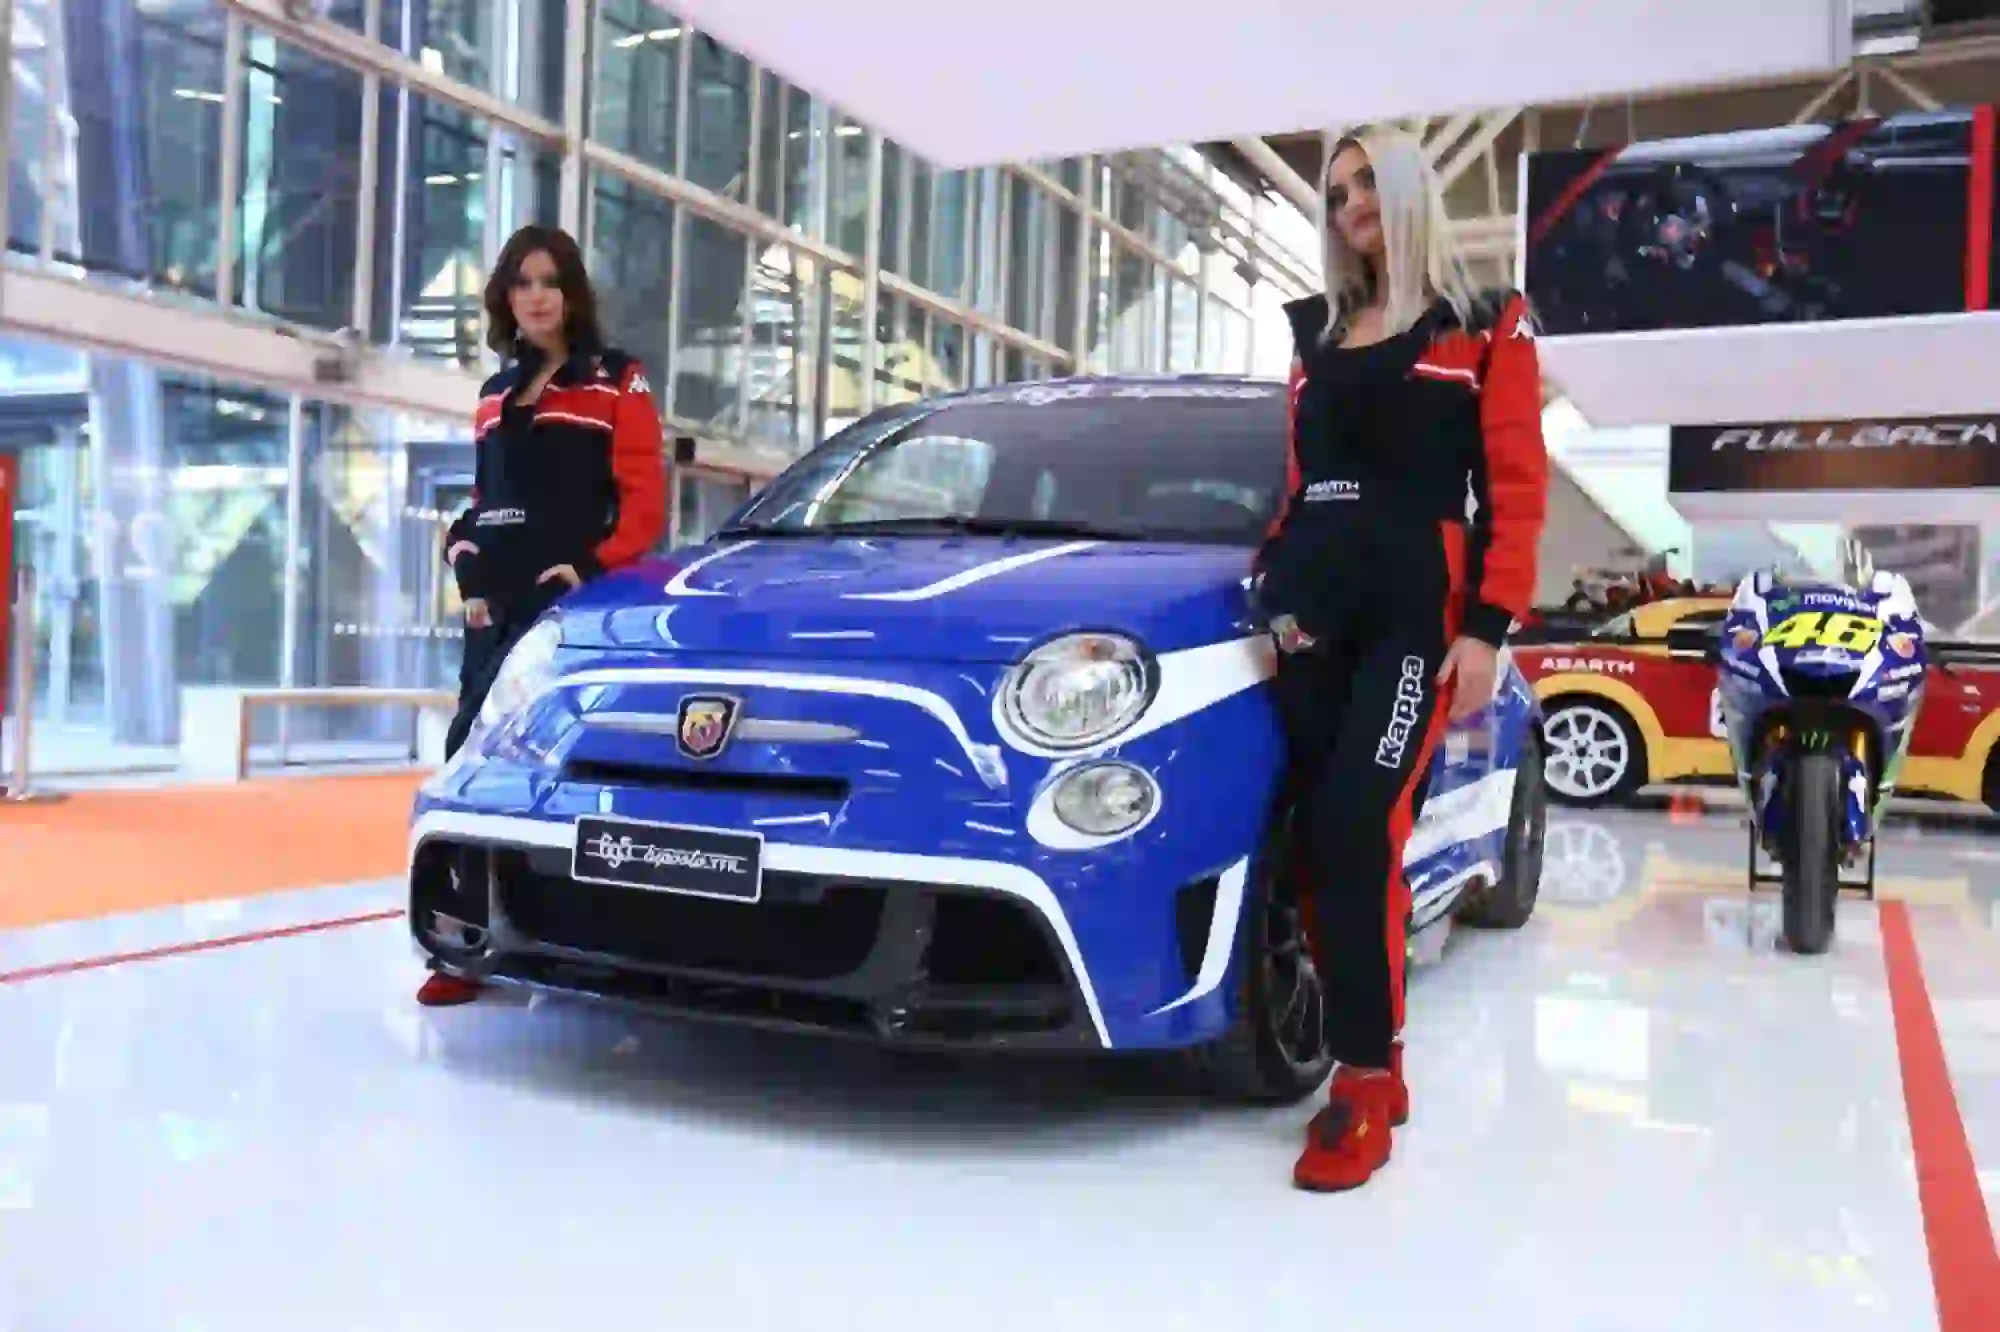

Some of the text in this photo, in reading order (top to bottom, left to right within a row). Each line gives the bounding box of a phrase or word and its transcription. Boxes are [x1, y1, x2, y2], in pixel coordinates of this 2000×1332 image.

[1711, 422, 1997, 450] FULLBACK
[1763, 612, 1884, 653] 46
[1540, 657, 1635, 675] ABARTH
[1375, 655, 1424, 768] Kappa
